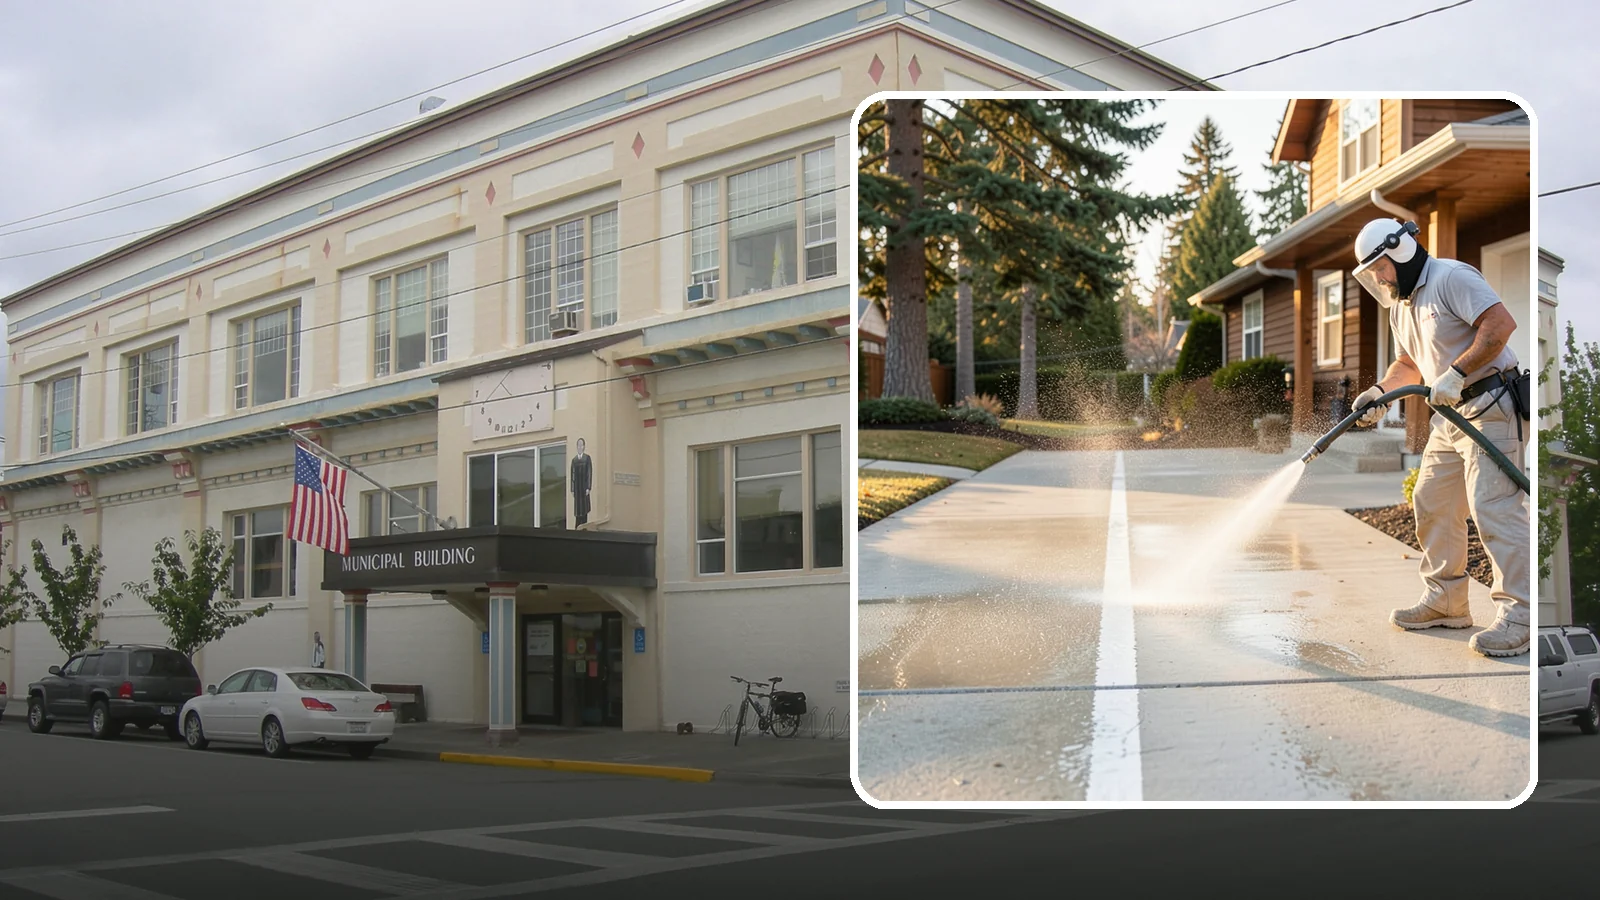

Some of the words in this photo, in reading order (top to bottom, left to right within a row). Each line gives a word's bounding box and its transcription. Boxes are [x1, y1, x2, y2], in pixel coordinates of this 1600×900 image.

[481, 407, 485, 415] 8
[488, 417, 492, 426] 9
[495, 423, 500, 432] 10
[521, 420, 525, 428] 2
[529, 414, 533, 422] 3
[536, 402, 540, 410] 4
[342, 552, 405, 572] MUNICIPAL
[414, 546, 475, 567] BUILDING
